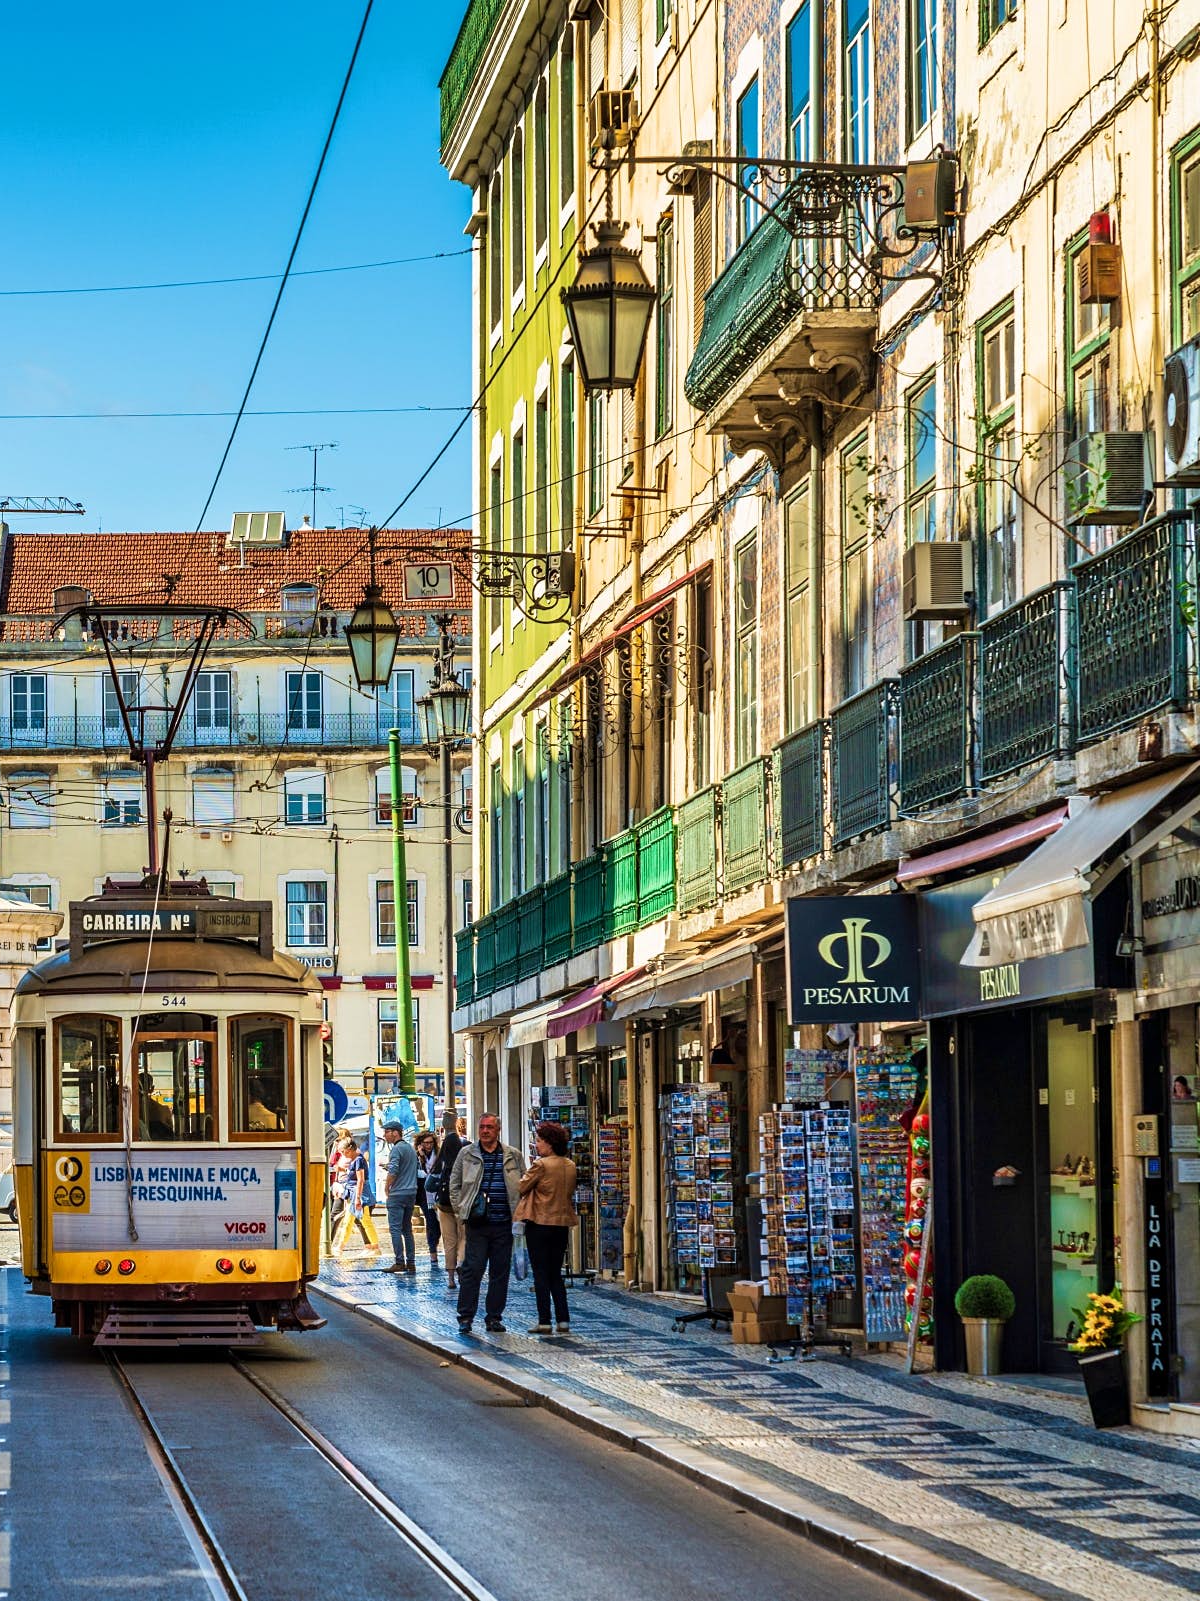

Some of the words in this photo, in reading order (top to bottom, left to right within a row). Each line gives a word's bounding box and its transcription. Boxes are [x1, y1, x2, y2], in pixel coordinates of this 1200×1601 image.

[417, 567, 439, 588] 10
[83, 914, 161, 931] CARREIRA
[16, 942, 25, 951] DE
[162, 996, 188, 1007] 544
[803, 986, 911, 1006] PESARUM
[94, 1167, 144, 1183] LISBOA
[149, 1167, 204, 1182] MENINA
[208, 1167, 216, 1182] E
[220, 1167, 261, 1187] MOÇA,
[131, 1186, 228, 1203] FRESQUINHA.
[224, 1222, 267, 1235] VIGOR
[1149, 1205, 1161, 1248] LUA
[1150, 1259, 1161, 1288] DE
[1151, 1298, 1164, 1371] PRATA
